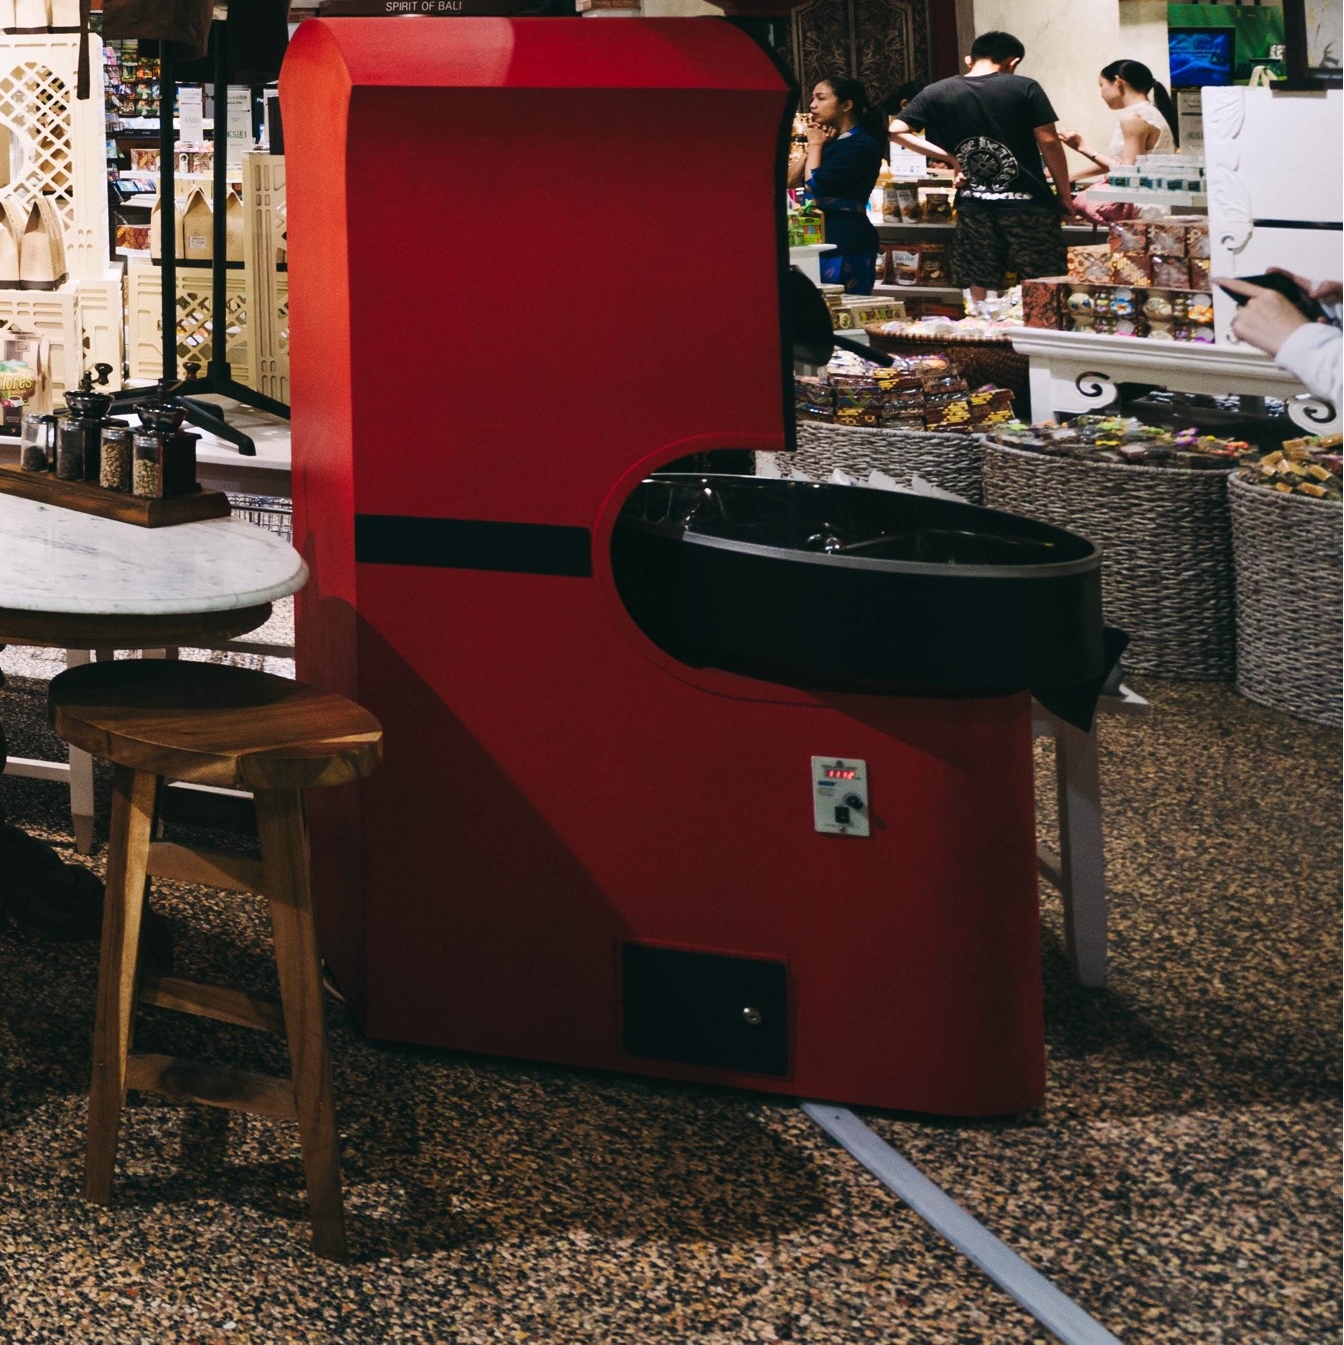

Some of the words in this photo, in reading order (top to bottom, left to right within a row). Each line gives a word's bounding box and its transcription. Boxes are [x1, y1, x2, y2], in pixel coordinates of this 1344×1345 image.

[385, 1, 418, 11] SPIRIT
[421, 1, 435, 11] OF
[438, 1, 462, 10] BALI
